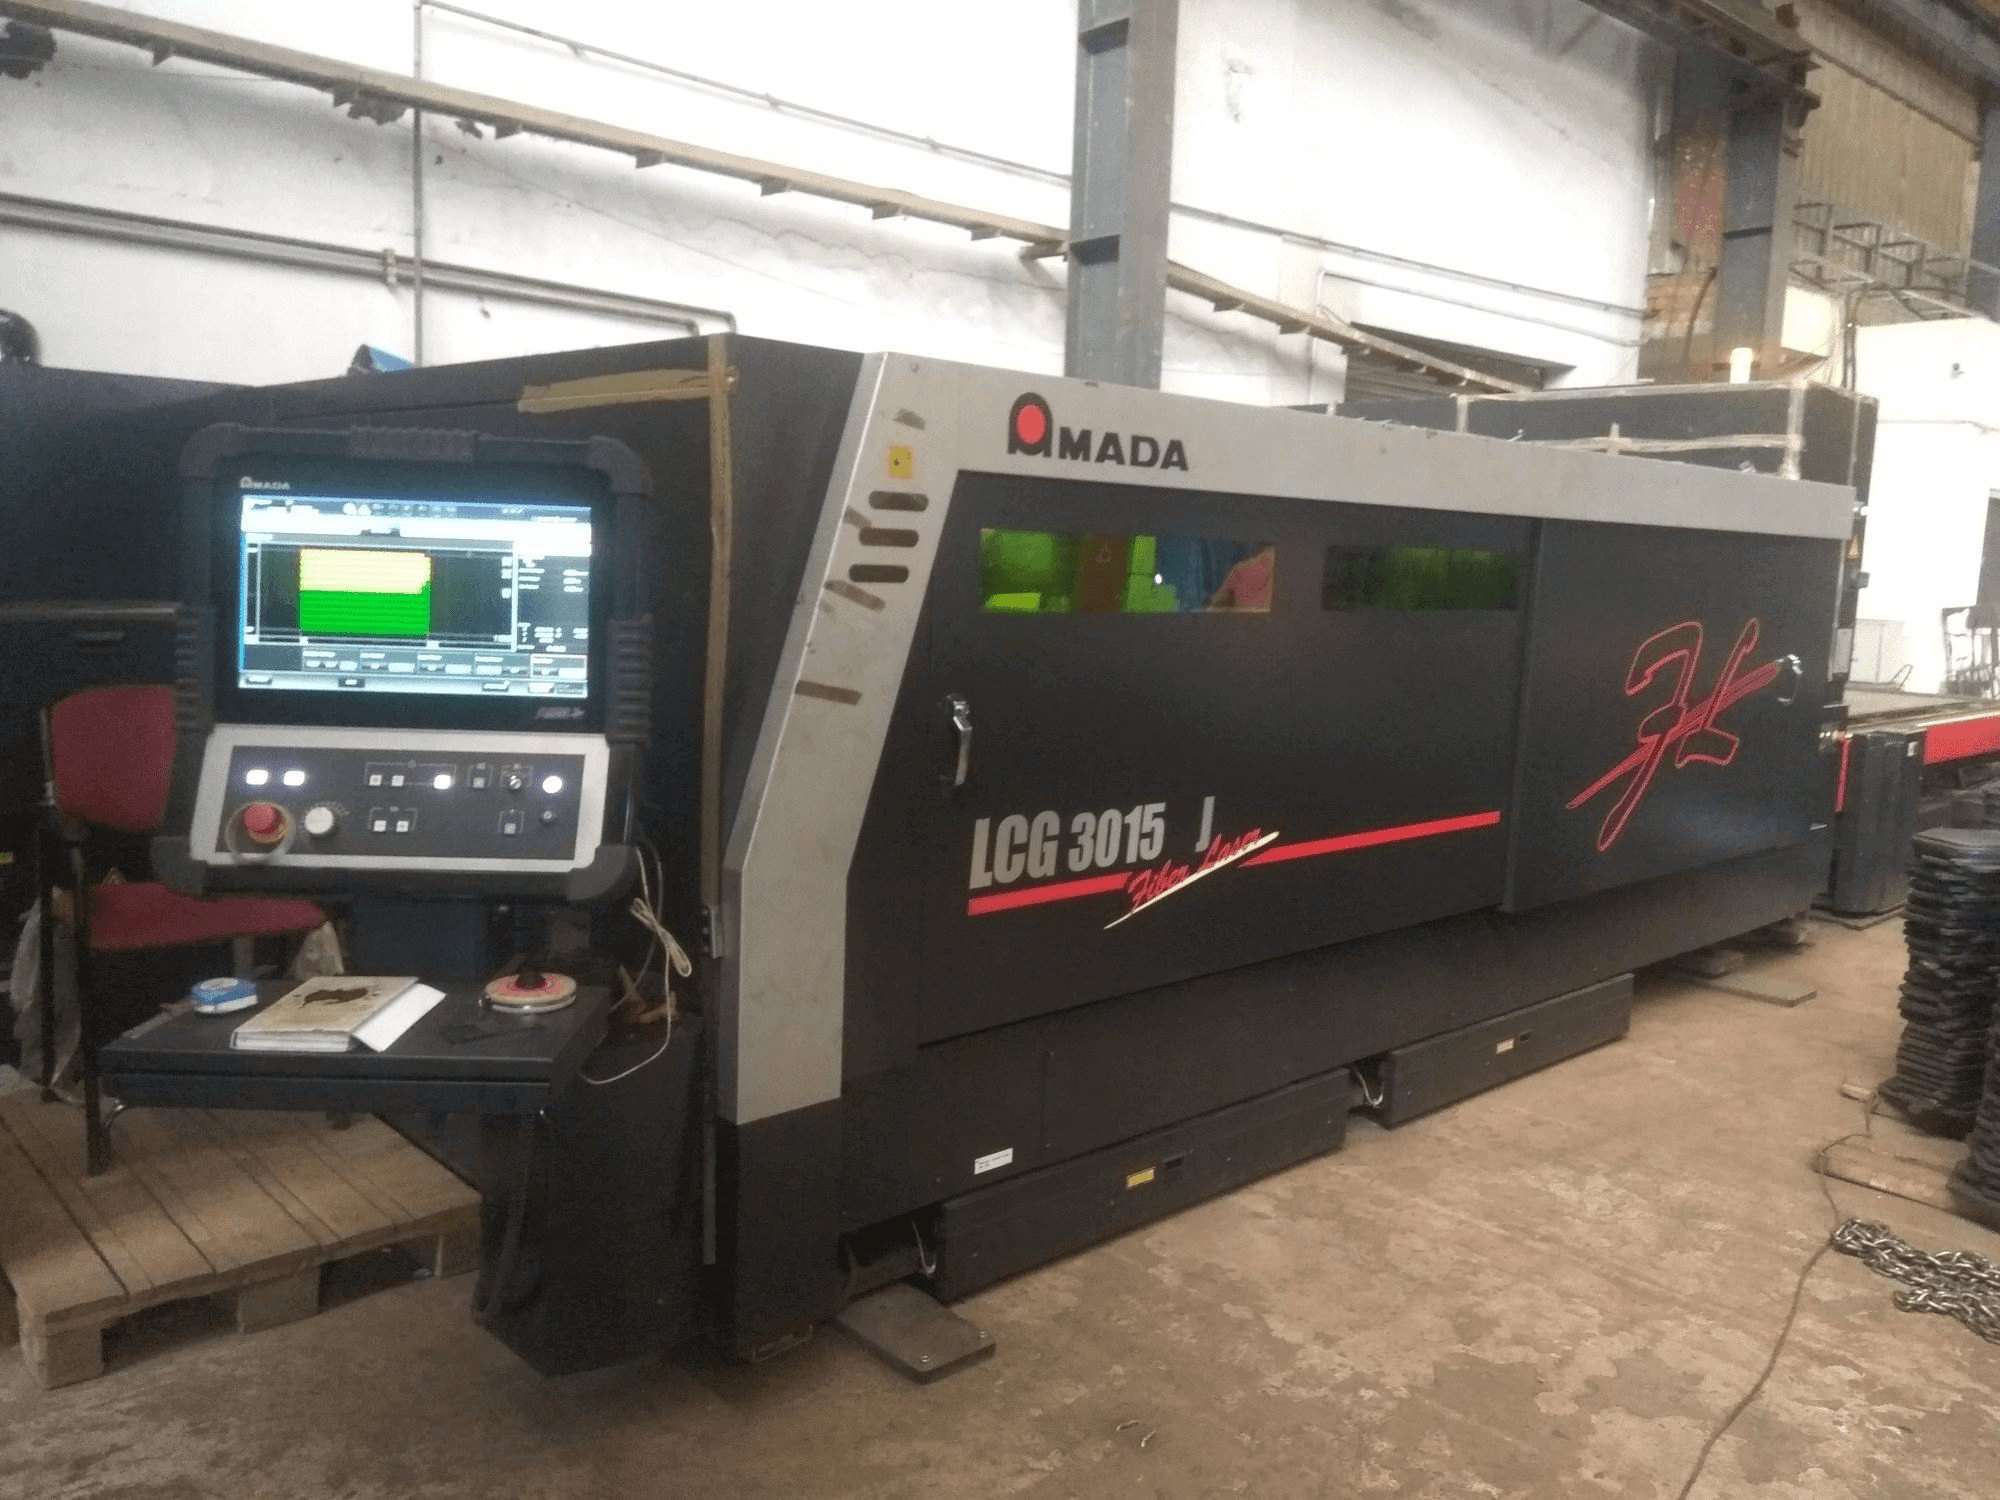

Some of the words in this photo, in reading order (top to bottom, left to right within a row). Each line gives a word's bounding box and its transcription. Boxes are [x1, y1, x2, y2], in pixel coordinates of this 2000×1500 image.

[968, 810, 1059, 890] LCG
[1067, 802, 1167, 872] 3015
[1194, 795, 1216, 853] J
[1127, 858, 1190, 913] Fiber
[1197, 827, 1262, 874] Laser
